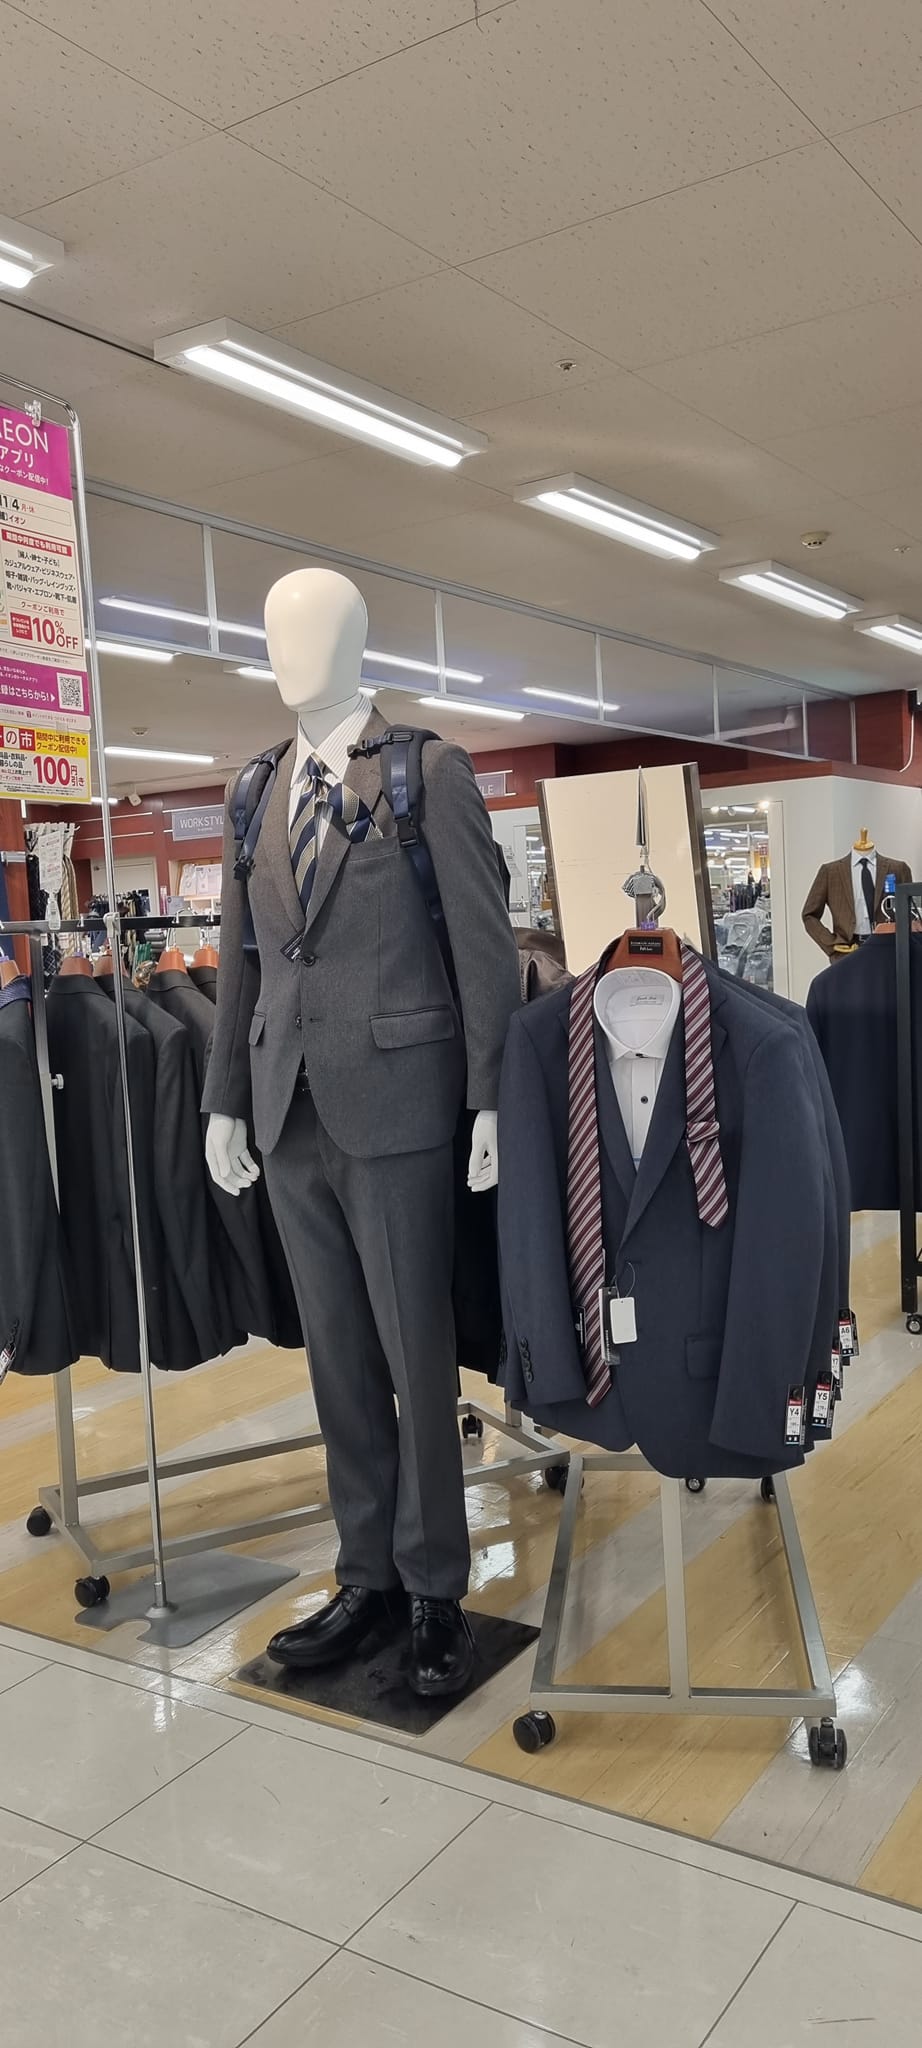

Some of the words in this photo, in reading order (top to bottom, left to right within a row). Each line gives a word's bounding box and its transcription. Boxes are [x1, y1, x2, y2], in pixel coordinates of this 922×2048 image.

[0, 418, 49, 453] EON
[0, 445, 34, 468] アプリ
[32, 617, 55, 645] 10
[54, 620, 65, 634] %
[56, 634, 79, 650] OFF
[0, 684, 50, 702] 録はこちらから!
[0, 730, 34, 749] の市
[36, 732, 87, 746] 期間中に利用できる
[36, 742, 78, 755] クーポン配信中!
[33, 755, 71, 786] 100
[841, 1326, 850, 1334] A6
[817, 1392, 828, 1401] Y5
[789, 1408, 800, 1417] Y4
